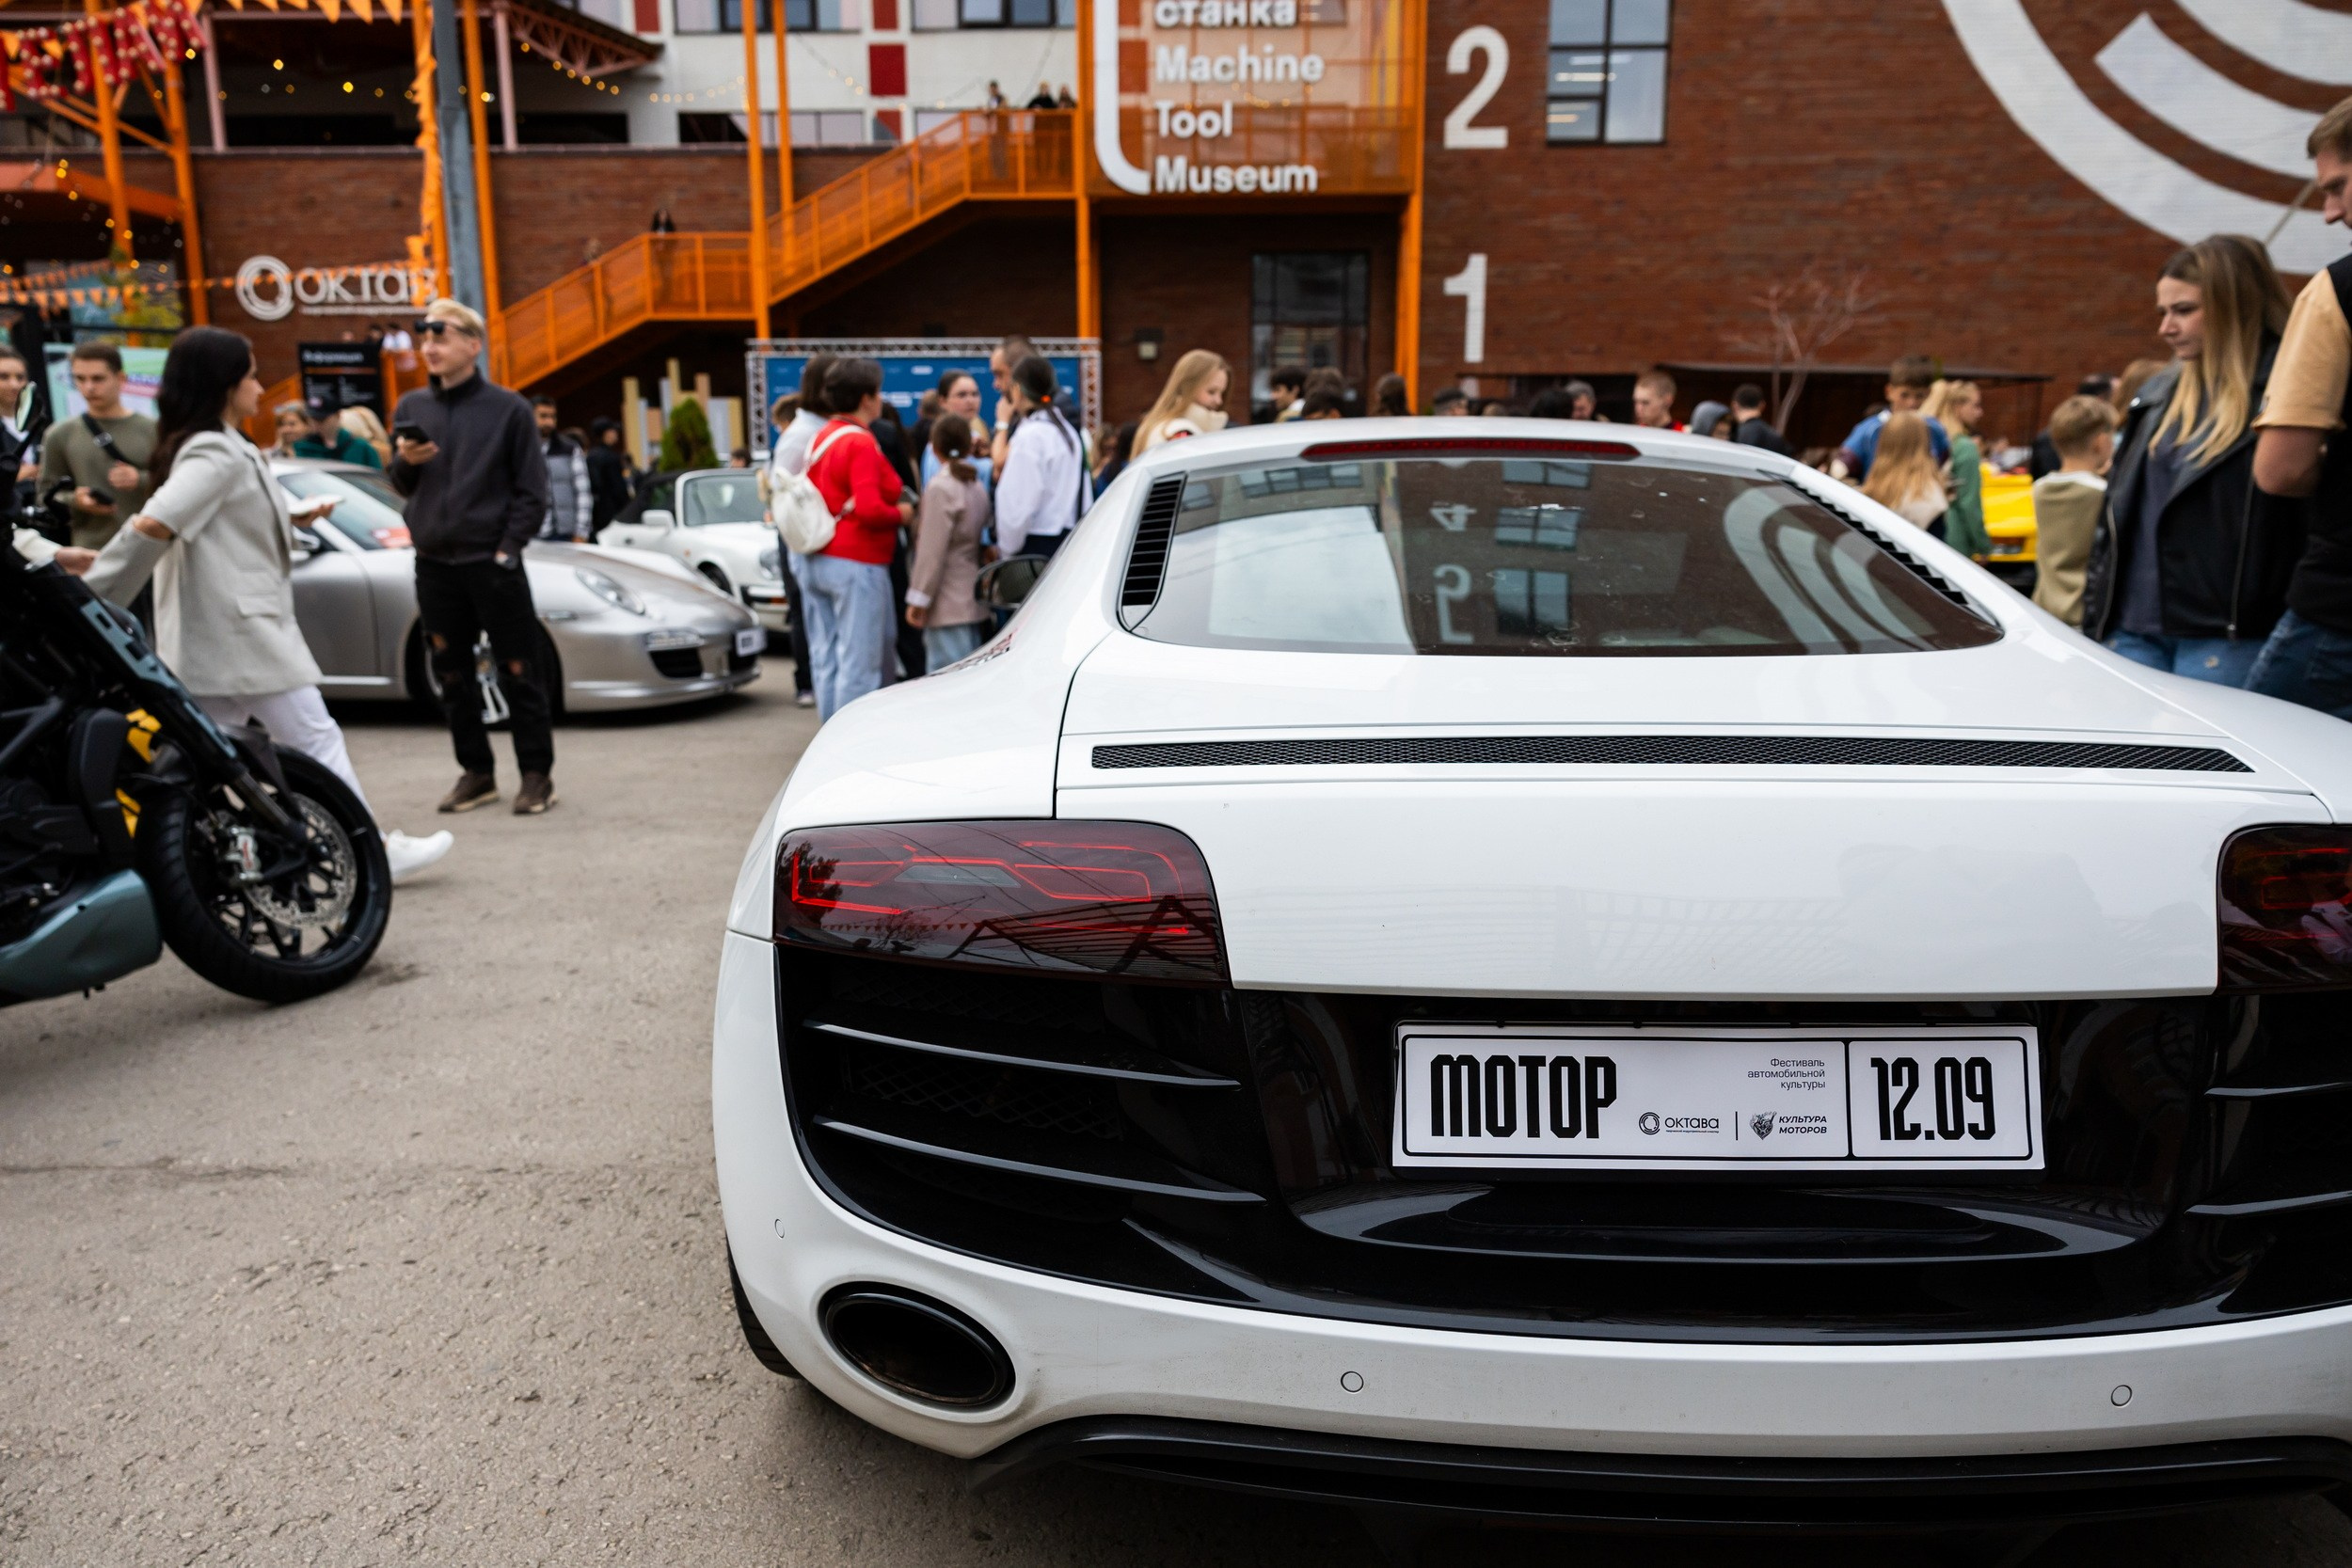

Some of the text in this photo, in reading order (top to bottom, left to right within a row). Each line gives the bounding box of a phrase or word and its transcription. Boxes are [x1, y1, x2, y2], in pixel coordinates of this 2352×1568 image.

[1153, 0, 1297, 28] станка
[1154, 43, 1325, 83] Machine
[1443, 24, 1510, 150] 2
[1155, 100, 1233, 138] Tool
[1155, 154, 1318, 193] Museum
[1442, 252, 1488, 363] 1
[1747, 1069, 1825, 1079] автомобильной
[1770, 1057, 1825, 1068] Фестиваль
[1430, 1053, 1617, 1139] МОТОР
[1780, 1081, 1826, 1091] культуры
[1870, 1056, 1996, 1141] 12.09
[1778, 1116, 1827, 1124] КУЛЬТУРА
[1778, 1126, 1828, 1134] МОТОРОВ
